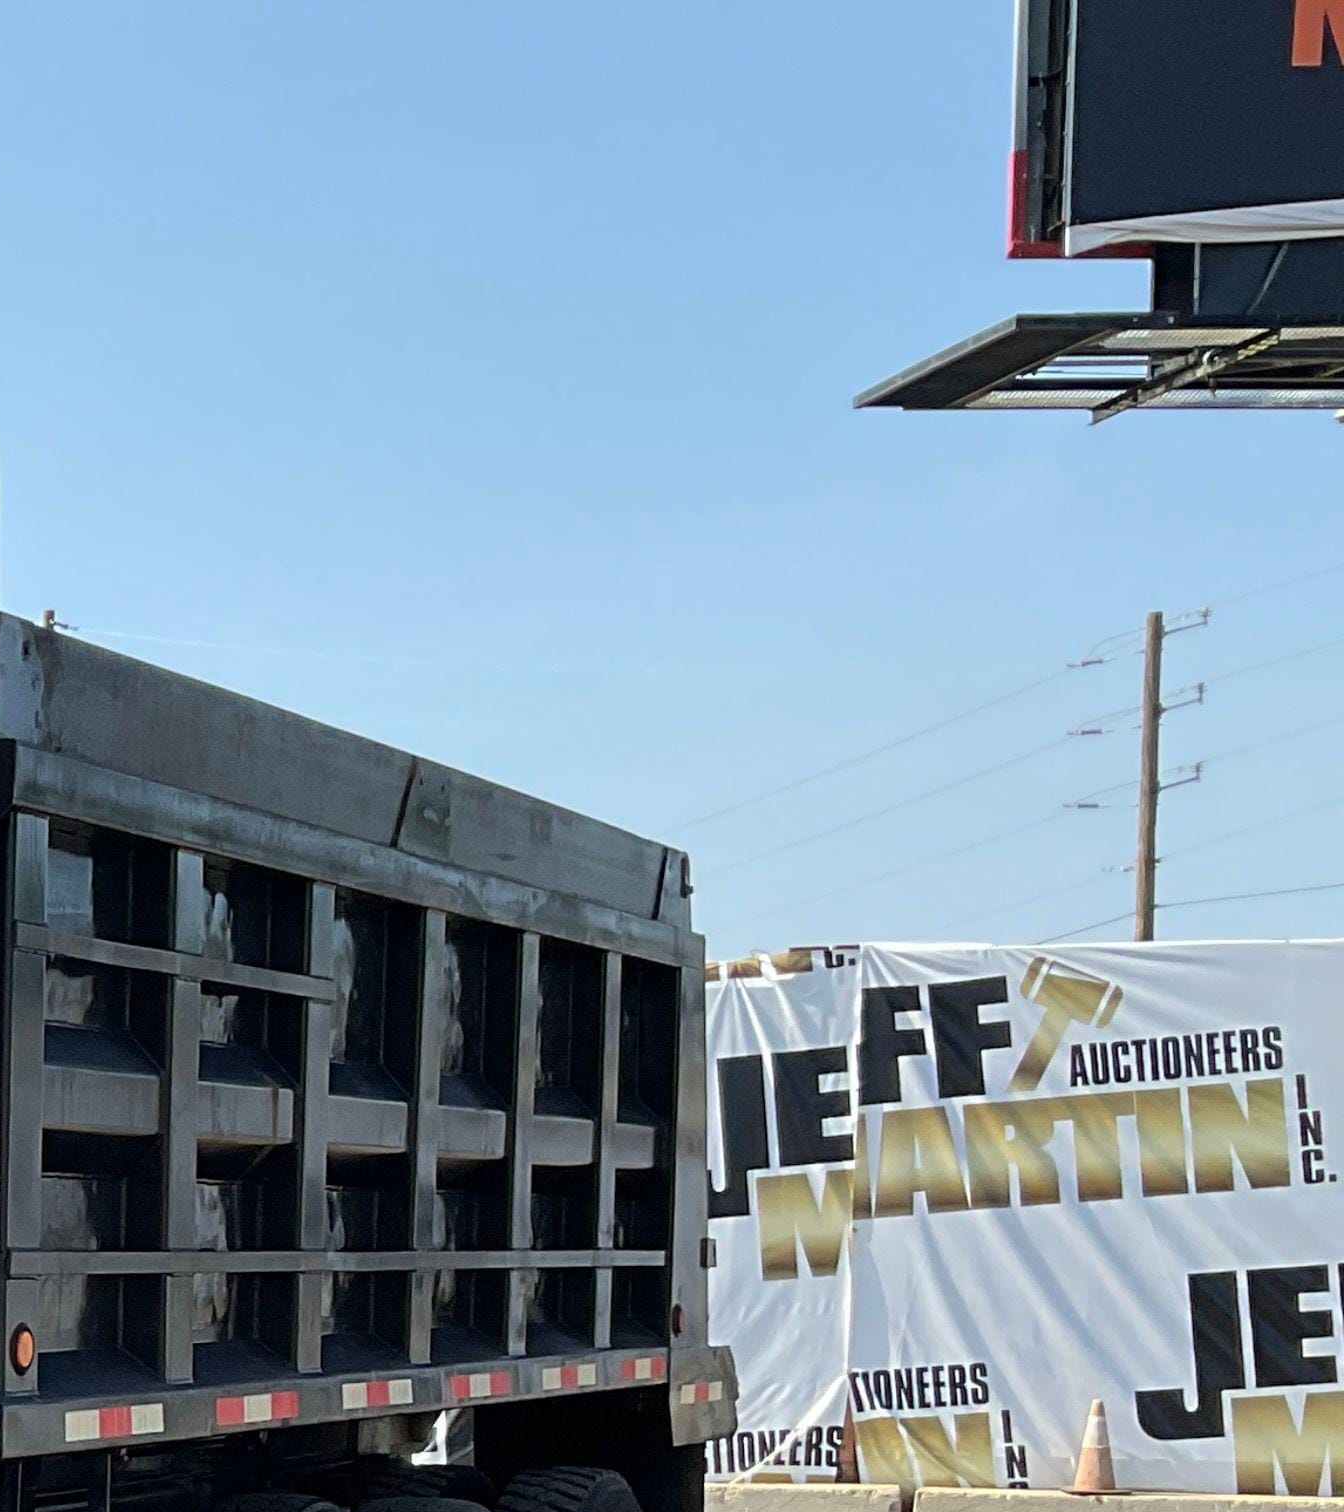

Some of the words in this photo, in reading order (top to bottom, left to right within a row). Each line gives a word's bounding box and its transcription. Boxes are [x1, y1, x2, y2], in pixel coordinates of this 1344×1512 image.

[1069, 1026, 1284, 1087] AUCTIONEERS
[757, 1077, 1291, 1281] MARTIN
[1135, 1263, 1344, 1441] JE
[704, 1426, 844, 1475] TIONEERS
